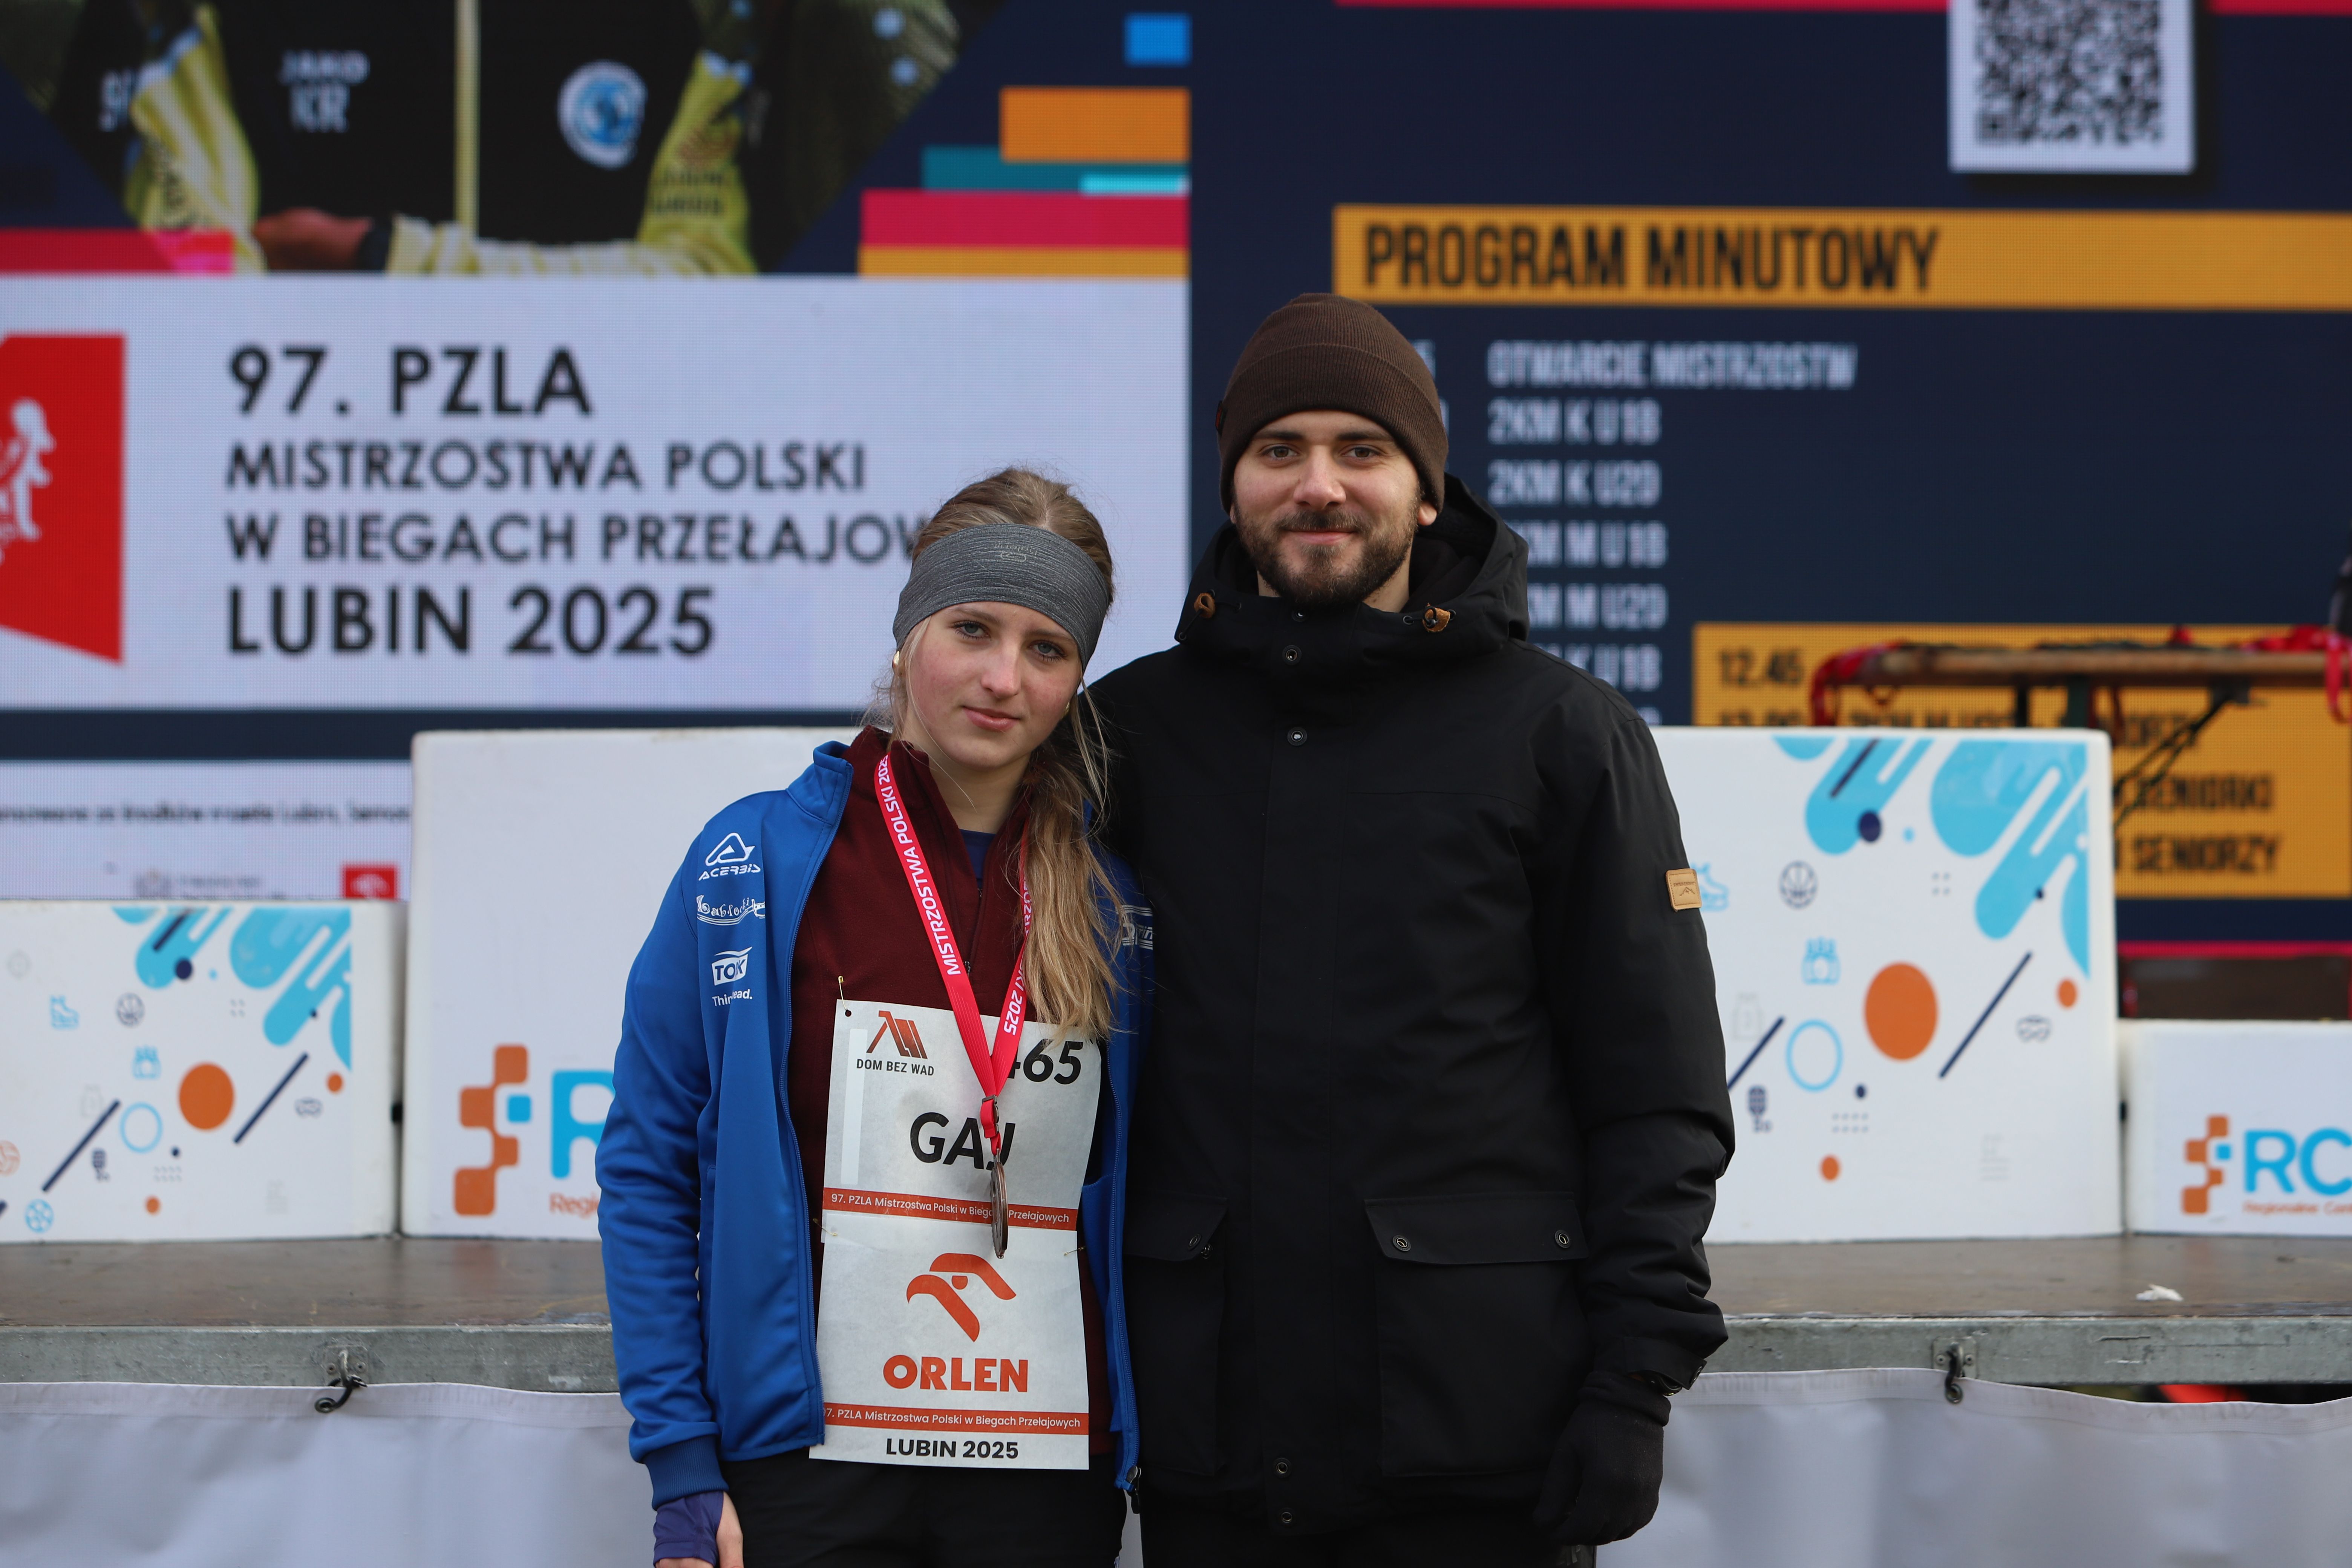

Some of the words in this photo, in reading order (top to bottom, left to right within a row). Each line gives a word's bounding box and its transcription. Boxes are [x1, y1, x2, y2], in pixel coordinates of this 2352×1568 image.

[1366, 225, 1627, 288] PROGRAM
[1647, 225, 1939, 291] MINUTOWY
[230, 343, 349, 417] 97.
[392, 344, 594, 417] PZLA
[1488, 340, 1648, 389] OTWARCIE
[1487, 397, 1562, 445] 2KM
[1564, 397, 1592, 445] K
[226, 439, 642, 491] MISTRZOSTWA
[666, 439, 865, 491] POLSKI
[1487, 459, 1562, 506] 2KM
[1564, 459, 1592, 506] K
[226, 511, 279, 562] W
[304, 510, 576, 564] BIEGACH
[230, 583, 469, 655] LUBIN
[507, 583, 715, 657] 2025
[880, 785, 913, 844] POLSKI
[2133, 832, 2280, 873] SENIORZY
[903, 846, 961, 975] MISTRZOSTWA
[1003, 989, 1023, 1036] 2025
[856, 1058, 882, 1070] DOM
[886, 1061, 907, 1073] BEZ
[911, 1064, 934, 1076] WAD
[910, 1112, 1015, 1171] GAJ
[831, 1193, 846, 1204] 97.
[848, 1195, 872, 1206] PZLA
[874, 1197, 931, 1212] Mistrzostwa
[933, 1202, 957, 1214] Polski
[1008, 1209, 1069, 1223] Przełajowych
[883, 1354, 1028, 1392] ORLEN
[838, 1409, 862, 1419] PZLA
[865, 1410, 929, 1424] Mistrzostwa
[932, 1414, 962, 1425] Polski
[975, 1415, 1016, 1428] Biegach
[1018, 1416, 1081, 1430] Przełajowych
[886, 1438, 957, 1458] LUBIN
[962, 1440, 1019, 1460] 2025
